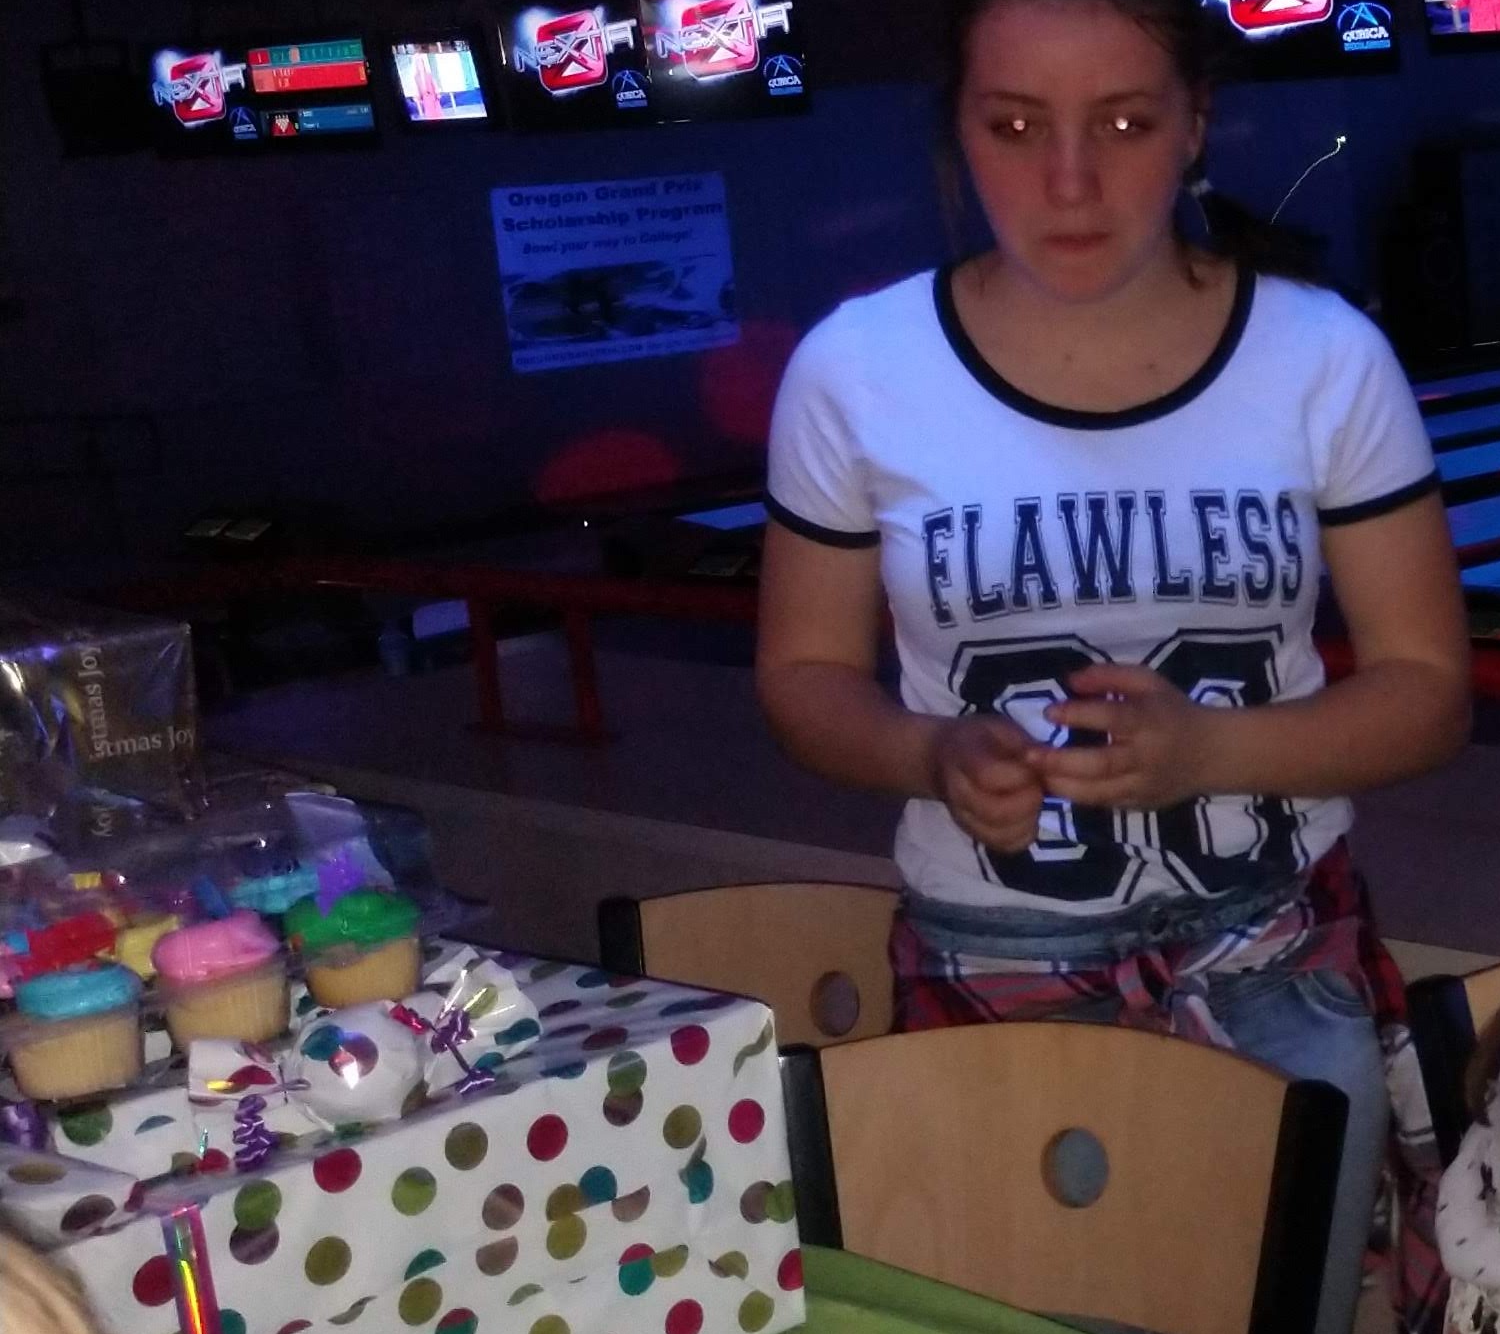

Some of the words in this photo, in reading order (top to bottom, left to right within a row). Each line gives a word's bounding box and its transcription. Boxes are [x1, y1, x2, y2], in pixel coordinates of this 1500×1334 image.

[507, 188, 588, 207] Oregon
[594, 182, 657, 201] Grand
[502, 209, 630, 233] Scholarship
[636, 201, 723, 222] Program
[921, 489, 1304, 628] FLAWLESS
